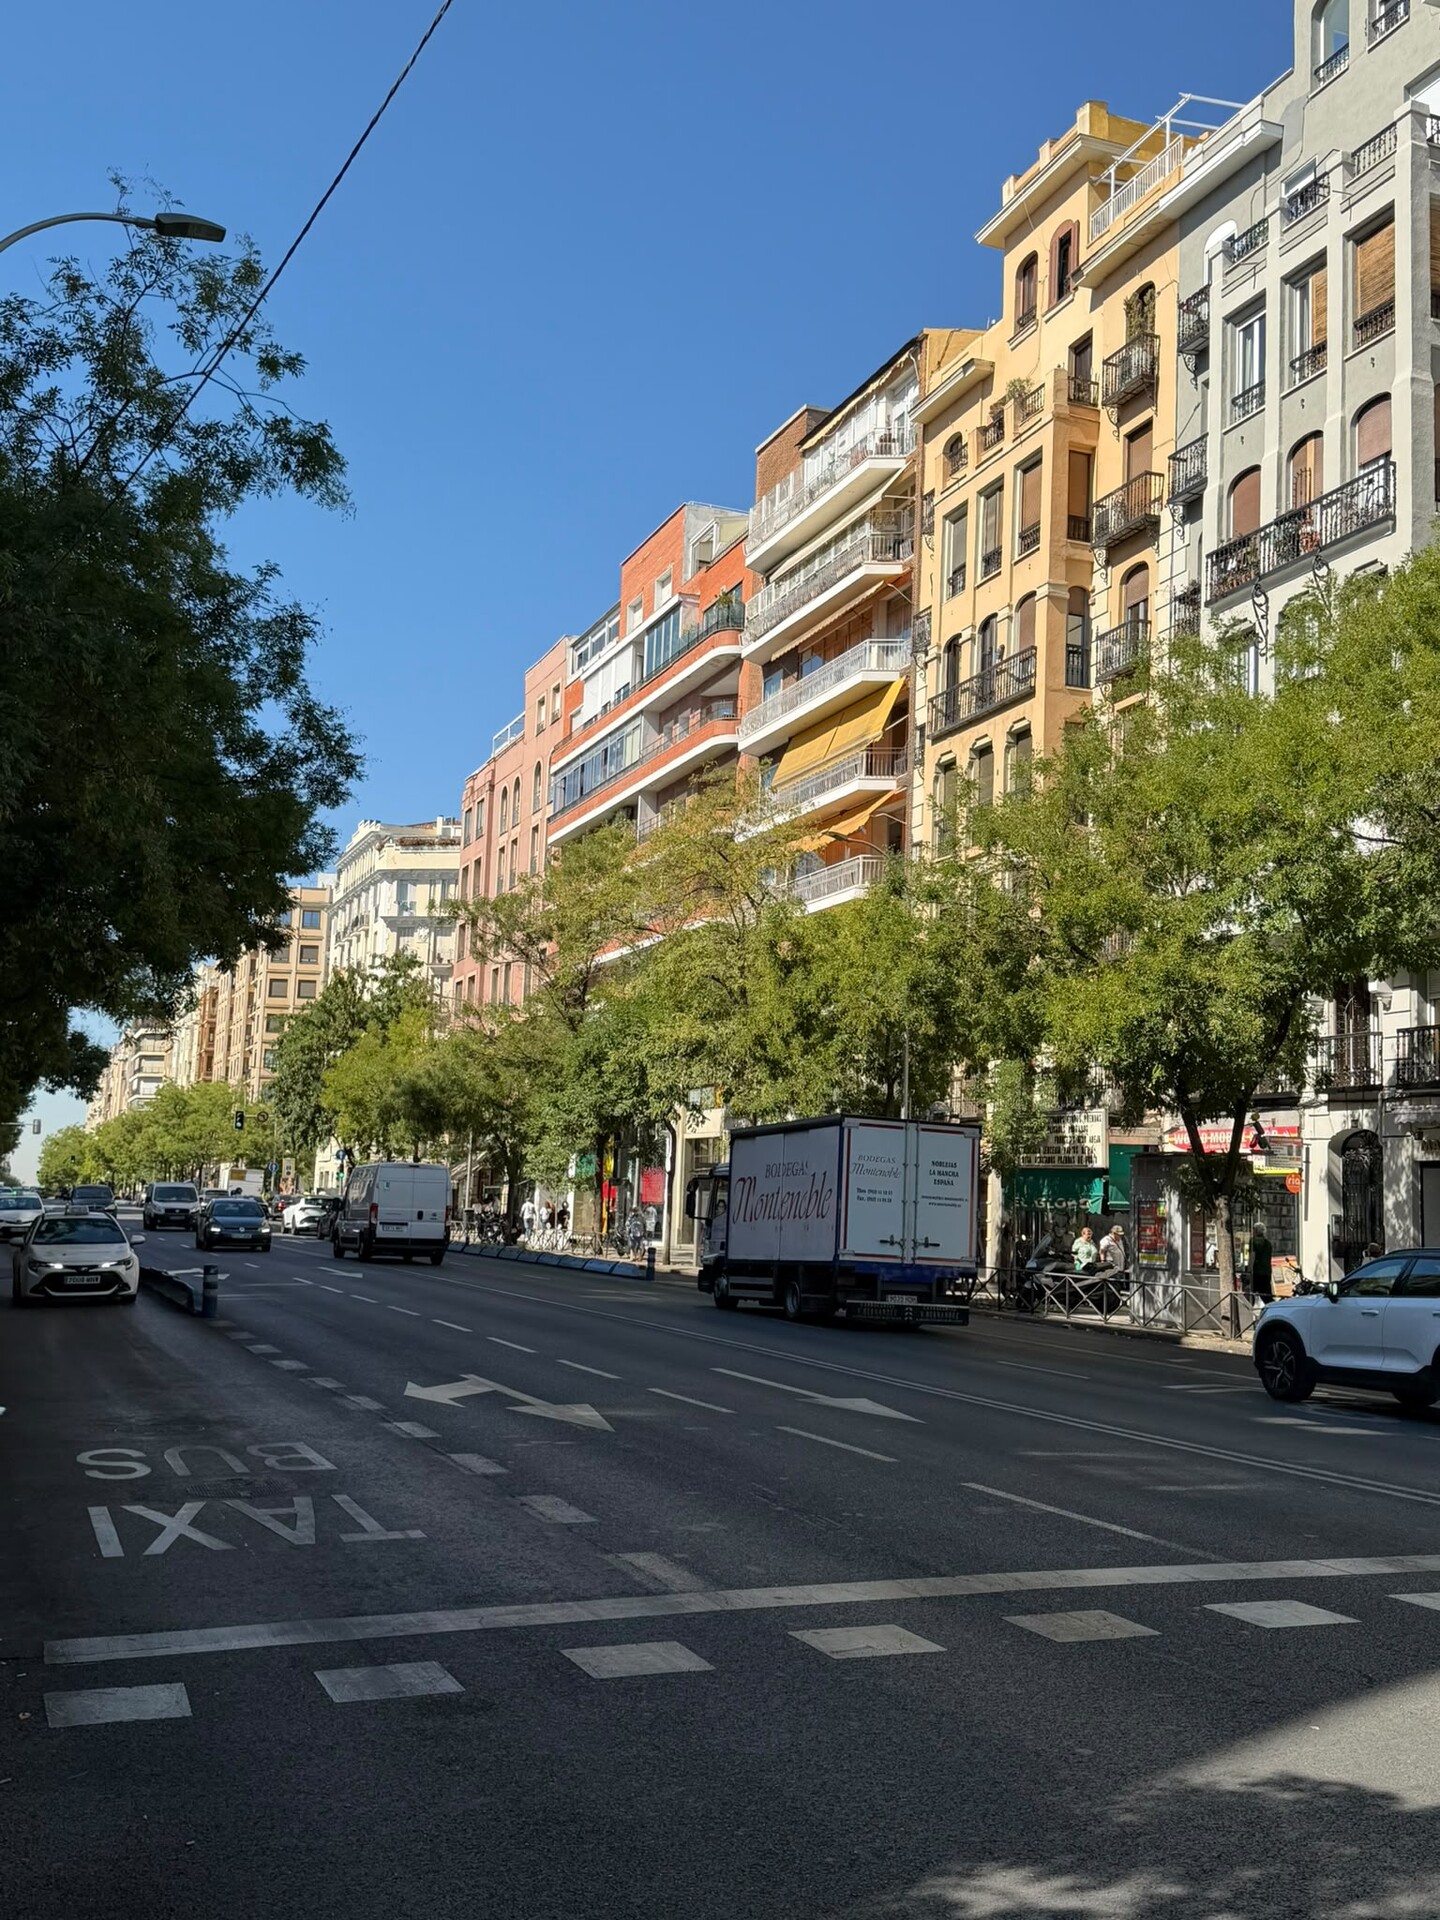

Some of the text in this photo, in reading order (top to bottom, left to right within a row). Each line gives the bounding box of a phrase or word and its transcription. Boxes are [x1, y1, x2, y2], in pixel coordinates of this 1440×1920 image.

[858, 1155, 896, 1164] BODEGAS
[931, 1160, 958, 1168] NOBLEJAS
[765, 1161, 809, 1178] BODEGAS
[850, 1162, 901, 1179] Montenoble
[933, 1178, 954, 1186] ESPAÑA
[1288, 1175, 1300, 1185] ria
[732, 1171, 833, 1224] Montenoble
[76, 1442, 338, 1479] BUS
[87, 1494, 427, 1558] TAXI
